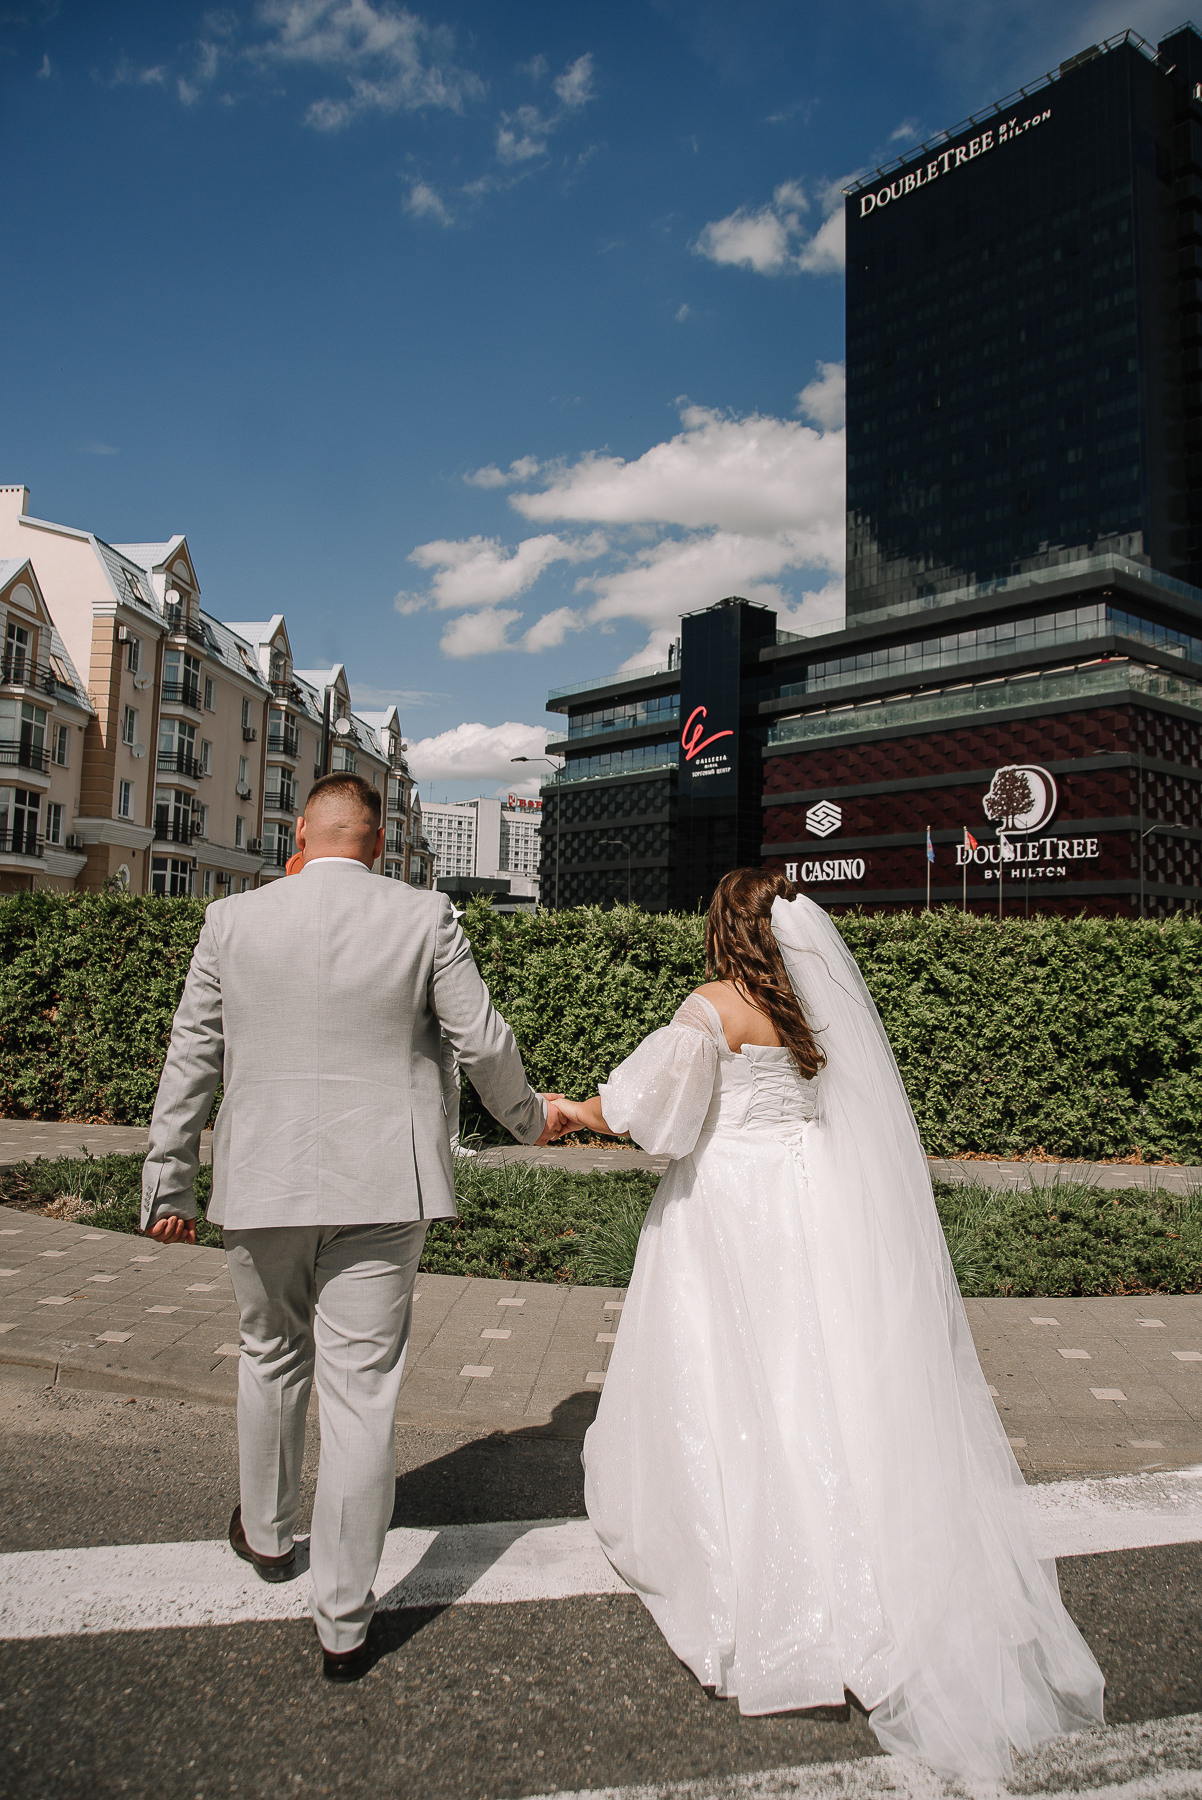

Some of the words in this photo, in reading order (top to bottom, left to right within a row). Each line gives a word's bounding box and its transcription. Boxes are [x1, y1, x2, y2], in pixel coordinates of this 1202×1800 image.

[999, 117, 1017, 133] BY
[999, 109, 1051, 144] HILTON
[695, 755, 727, 765] GALLERIA
[801, 858, 866, 882] CASINO
[984, 869, 1001, 879] BY
[1011, 866, 1066, 878] HILTON
